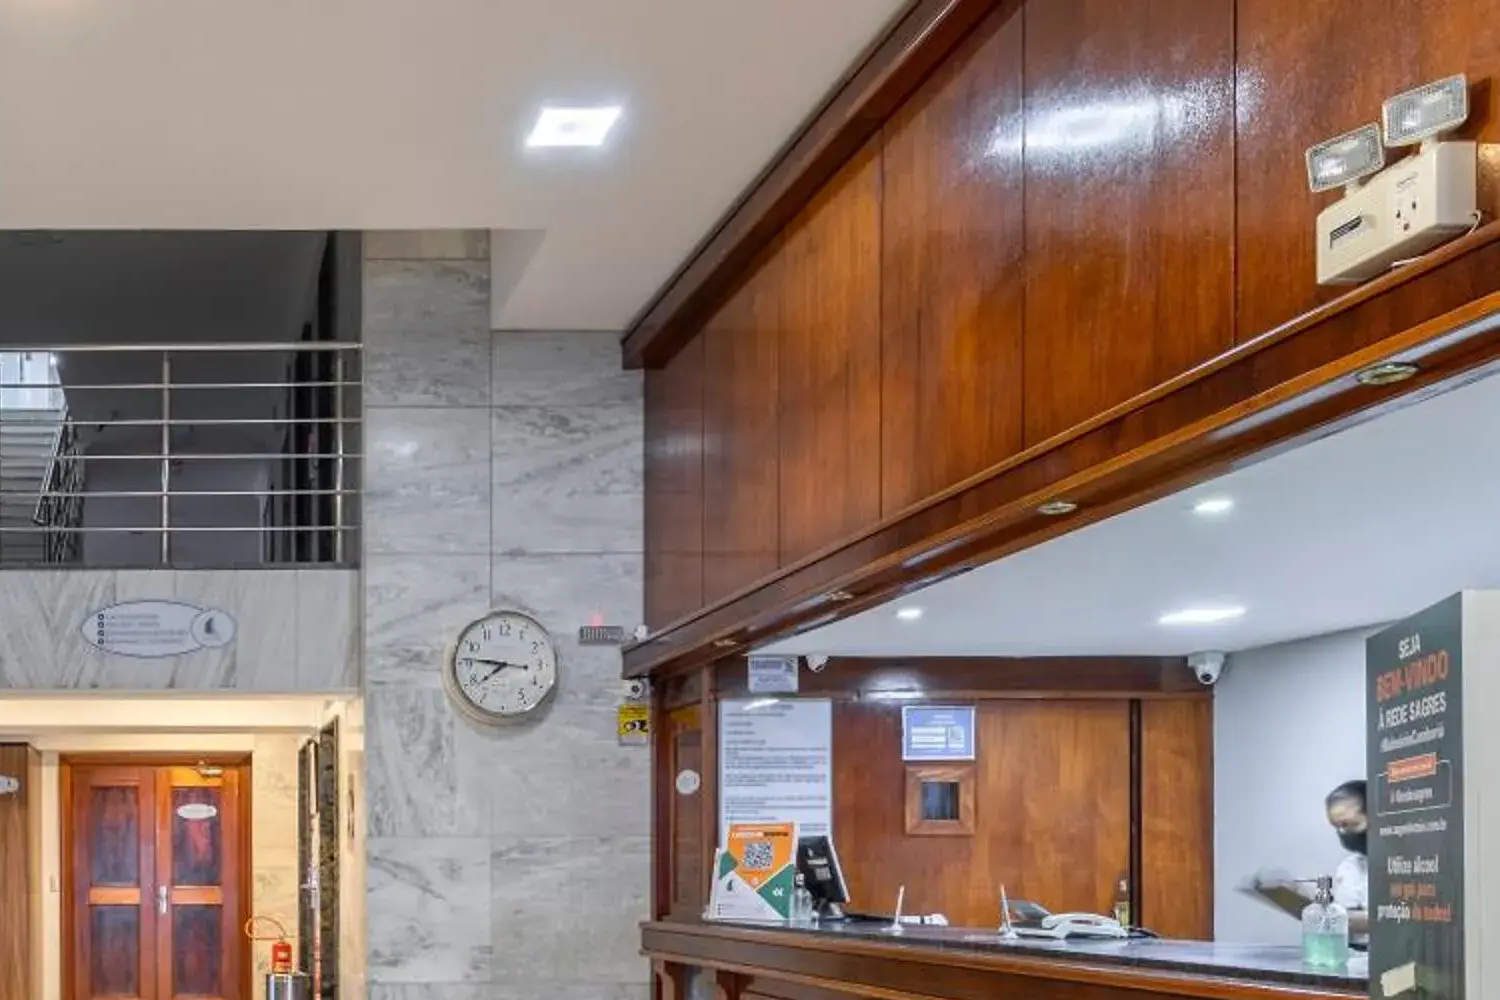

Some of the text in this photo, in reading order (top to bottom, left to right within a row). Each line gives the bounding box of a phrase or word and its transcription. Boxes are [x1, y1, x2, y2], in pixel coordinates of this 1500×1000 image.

[483, 629, 491, 641] 11
[499, 624, 511, 637] 12
[469, 642, 481, 653] 10
[1398, 632, 1421, 660] SEJA
[1386, 704, 1408, 729] REDE
[1409, 691, 1447, 721] SAGRES
